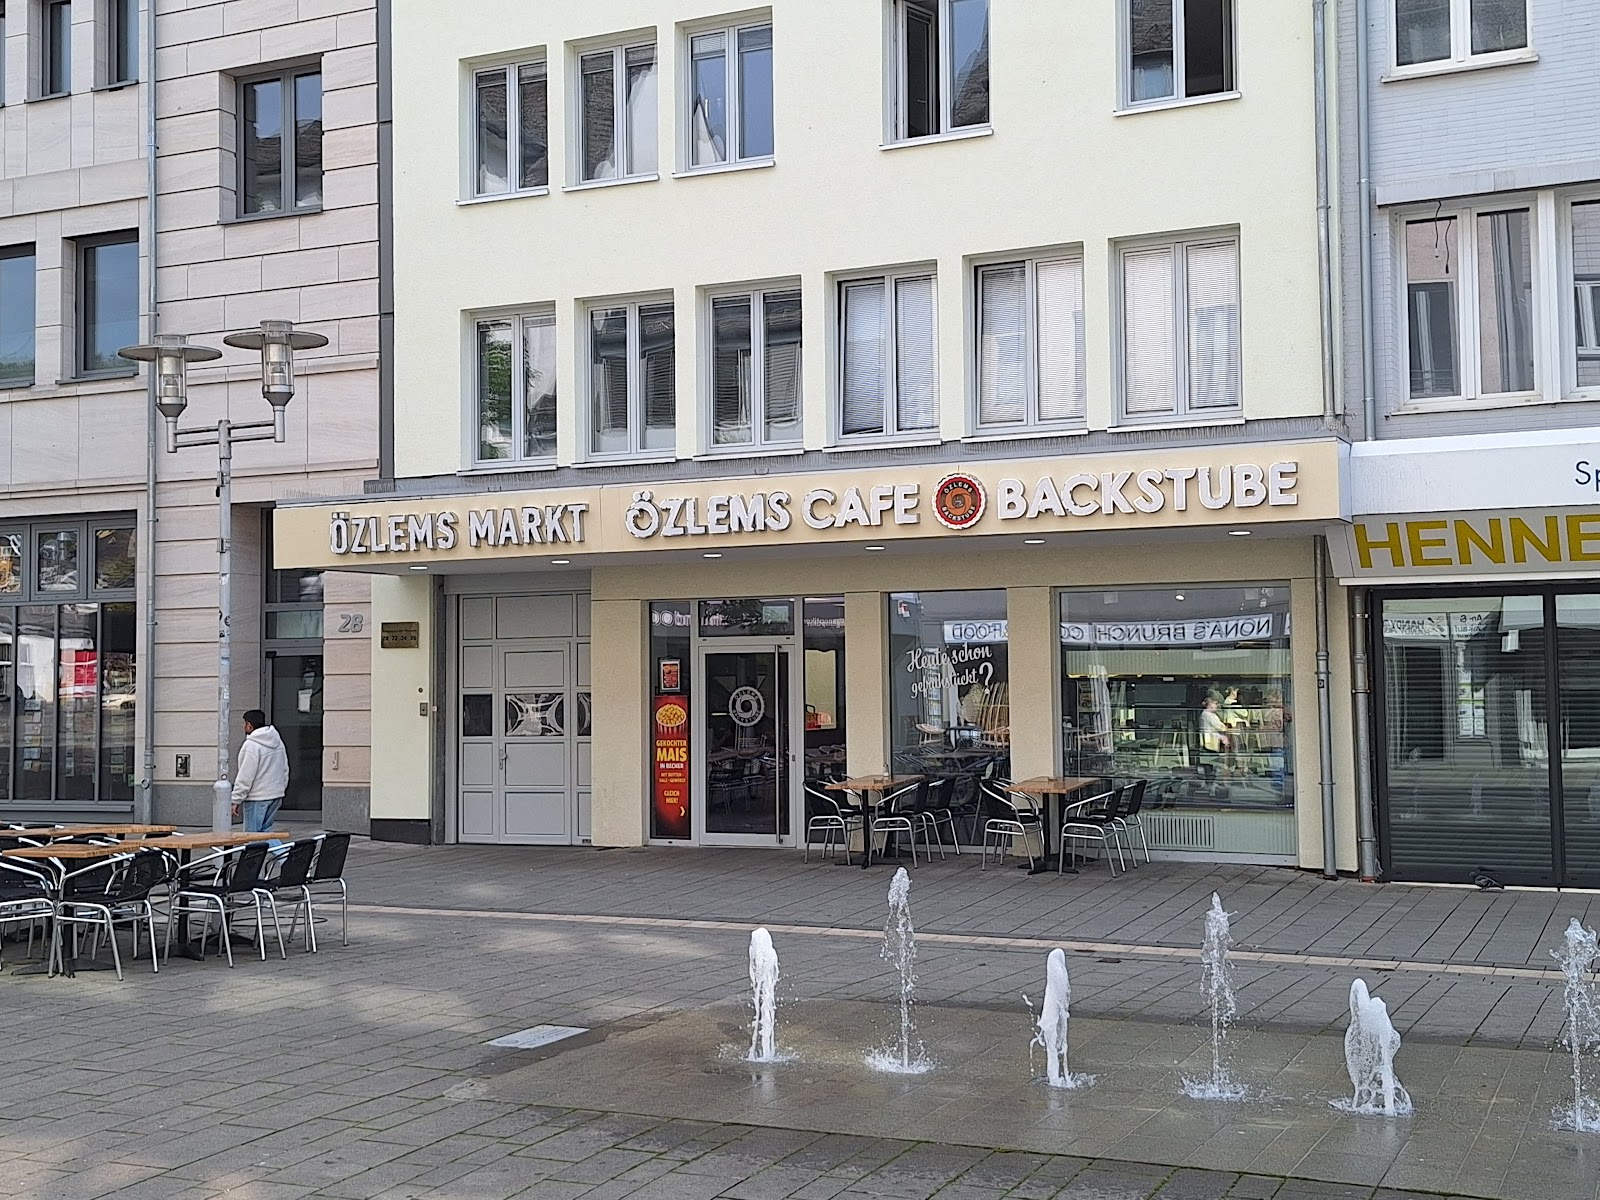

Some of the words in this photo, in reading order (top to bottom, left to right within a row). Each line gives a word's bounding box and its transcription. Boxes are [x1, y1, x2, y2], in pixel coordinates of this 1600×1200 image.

[625, 491, 791, 538] ÖZLEMS
[802, 483, 921, 529] CAFE
[997, 462, 1299, 520] BACKSTUBE
[330, 511, 459, 554] ÖZLEMS
[469, 503, 589, 547] MARKT
[1353, 513, 1600, 569] HENNE
[338, 614, 364, 633] 28
[906, 648, 950, 672] Heute
[951, 642, 992, 665] schon
[656, 739, 687, 747] GEKOCHTER
[656, 747, 688, 762] MAIS
